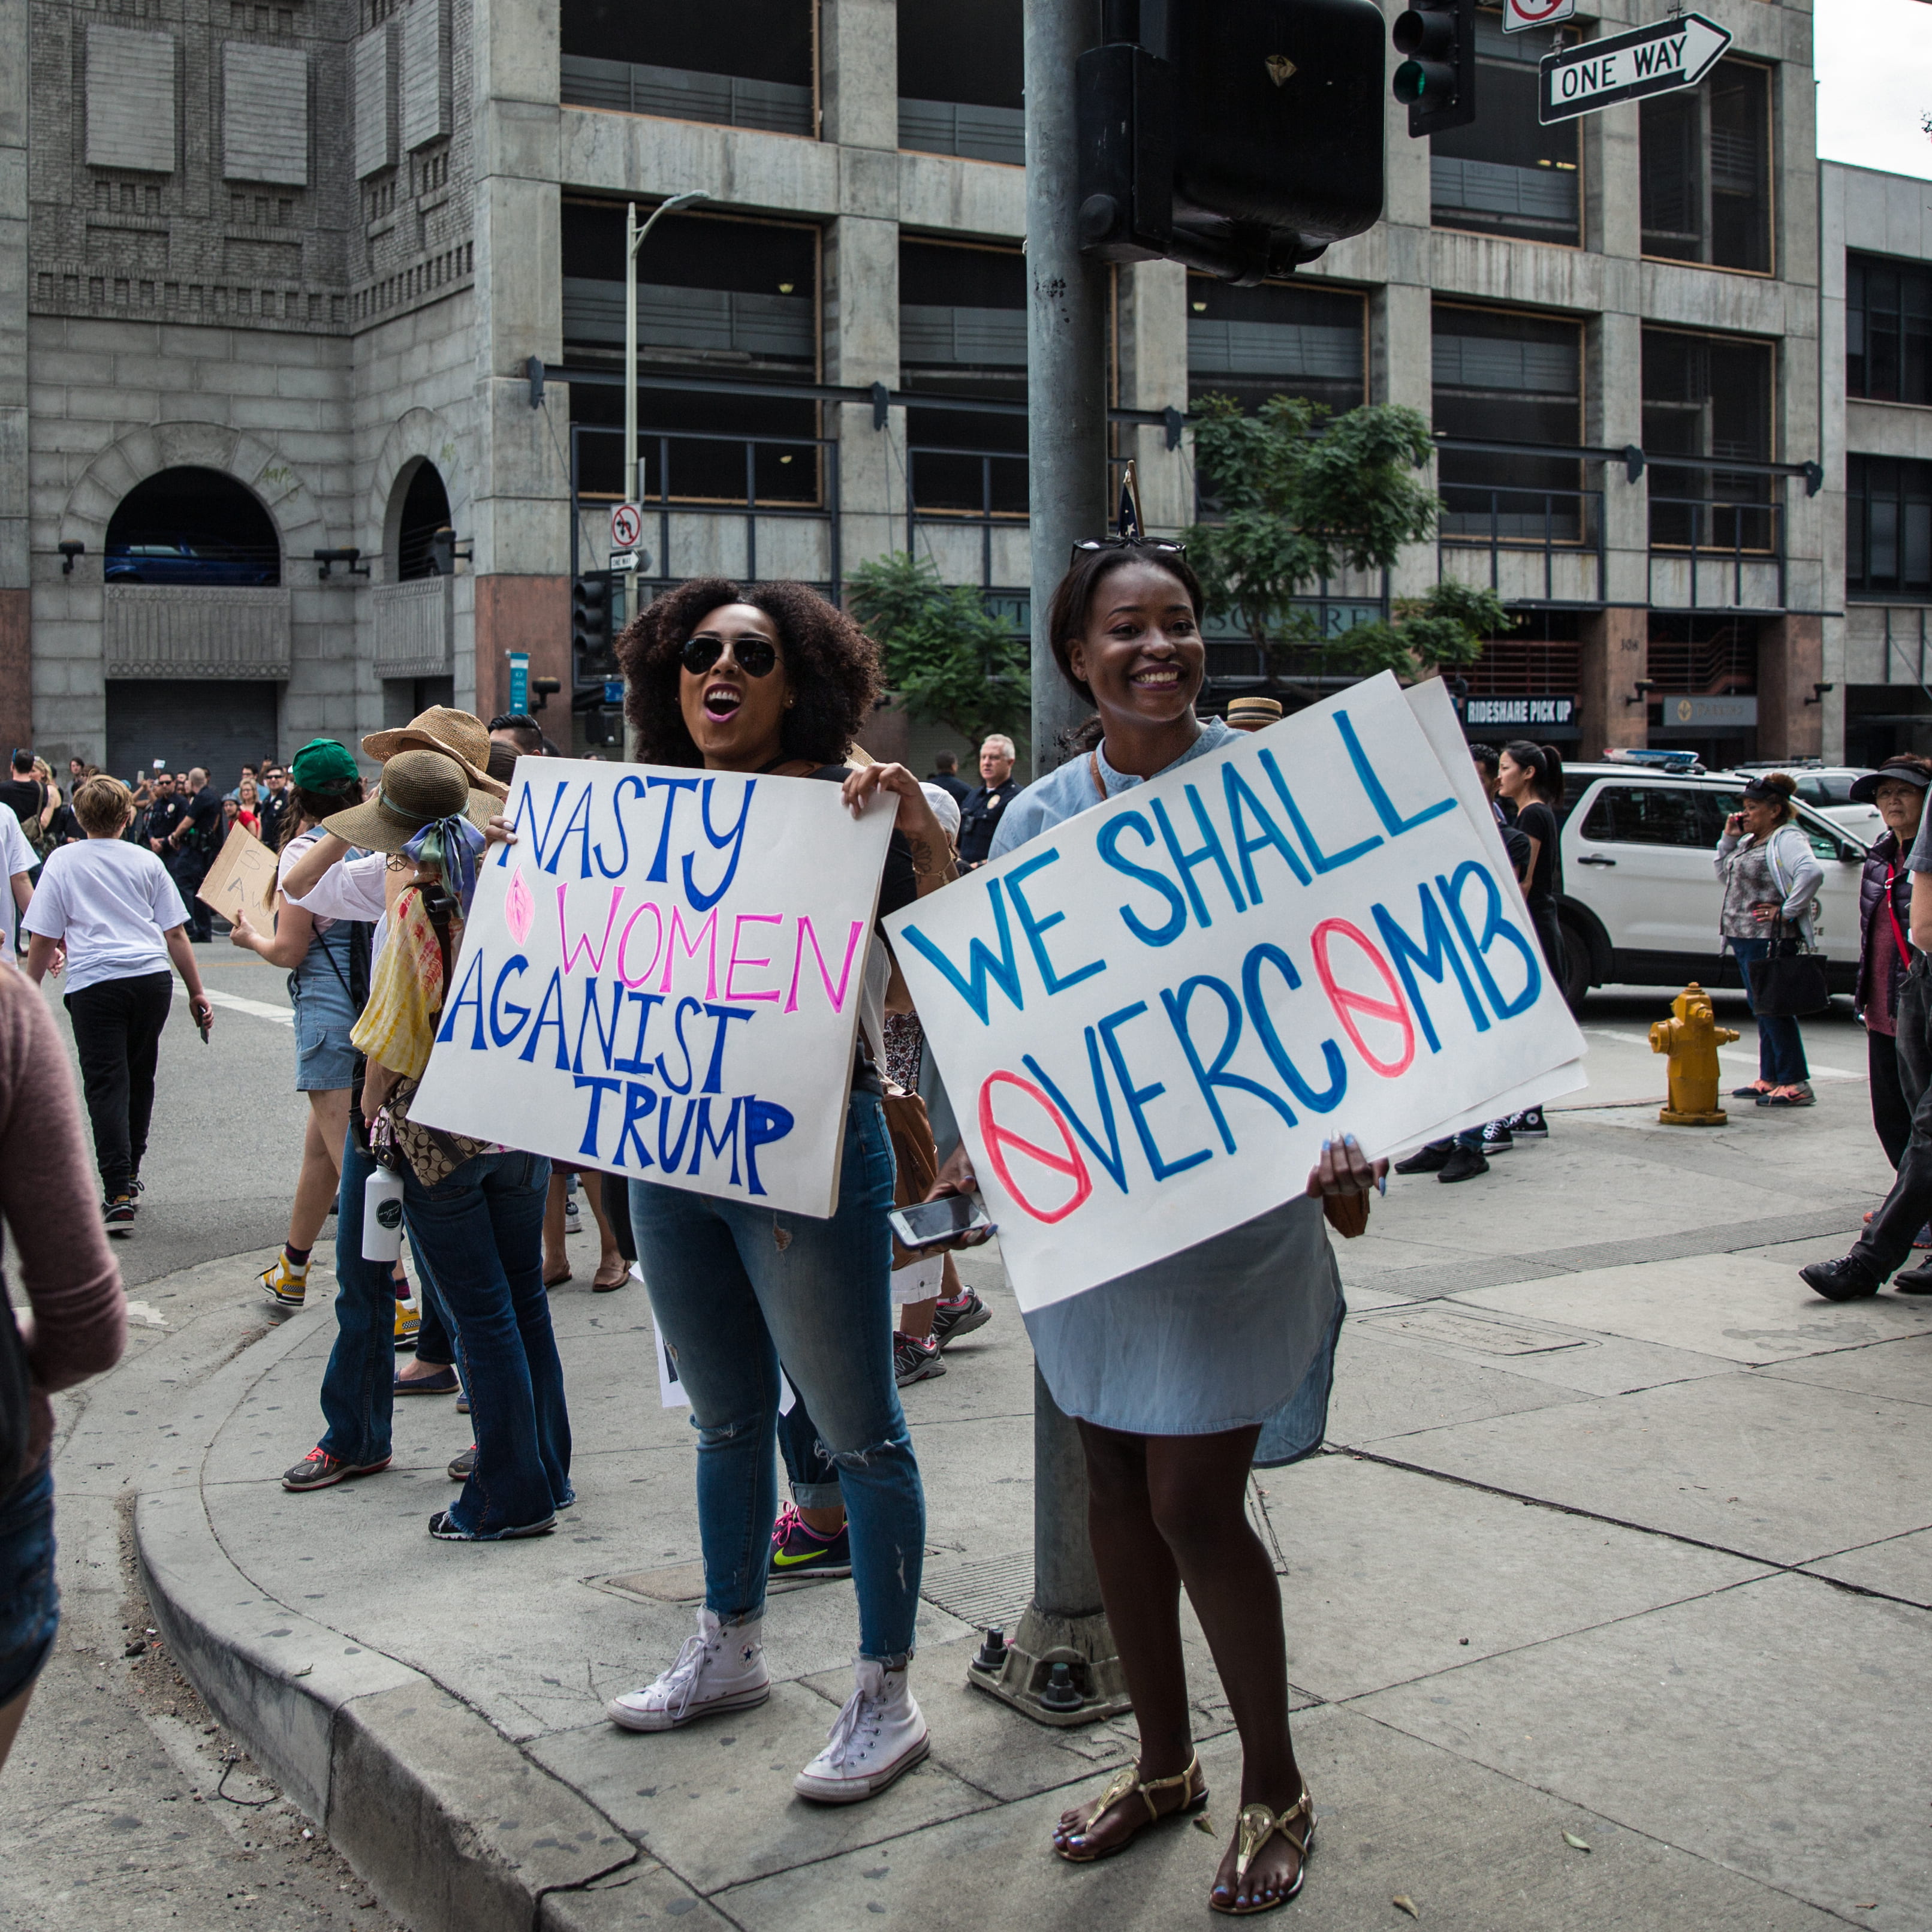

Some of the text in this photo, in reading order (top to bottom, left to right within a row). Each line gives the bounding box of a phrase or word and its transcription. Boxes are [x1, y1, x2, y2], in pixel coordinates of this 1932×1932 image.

[1562, 35, 1687, 98] ONE WAY
[1467, 700, 1572, 724] RIDESHARE PICK UP
[497, 775, 757, 912] NASTY
[901, 710, 1457, 1026] WE SHALL
[556, 882, 864, 1014] WOMEN
[436, 948, 756, 1095] AGANIST
[572, 1075, 795, 1196] TRUMP
